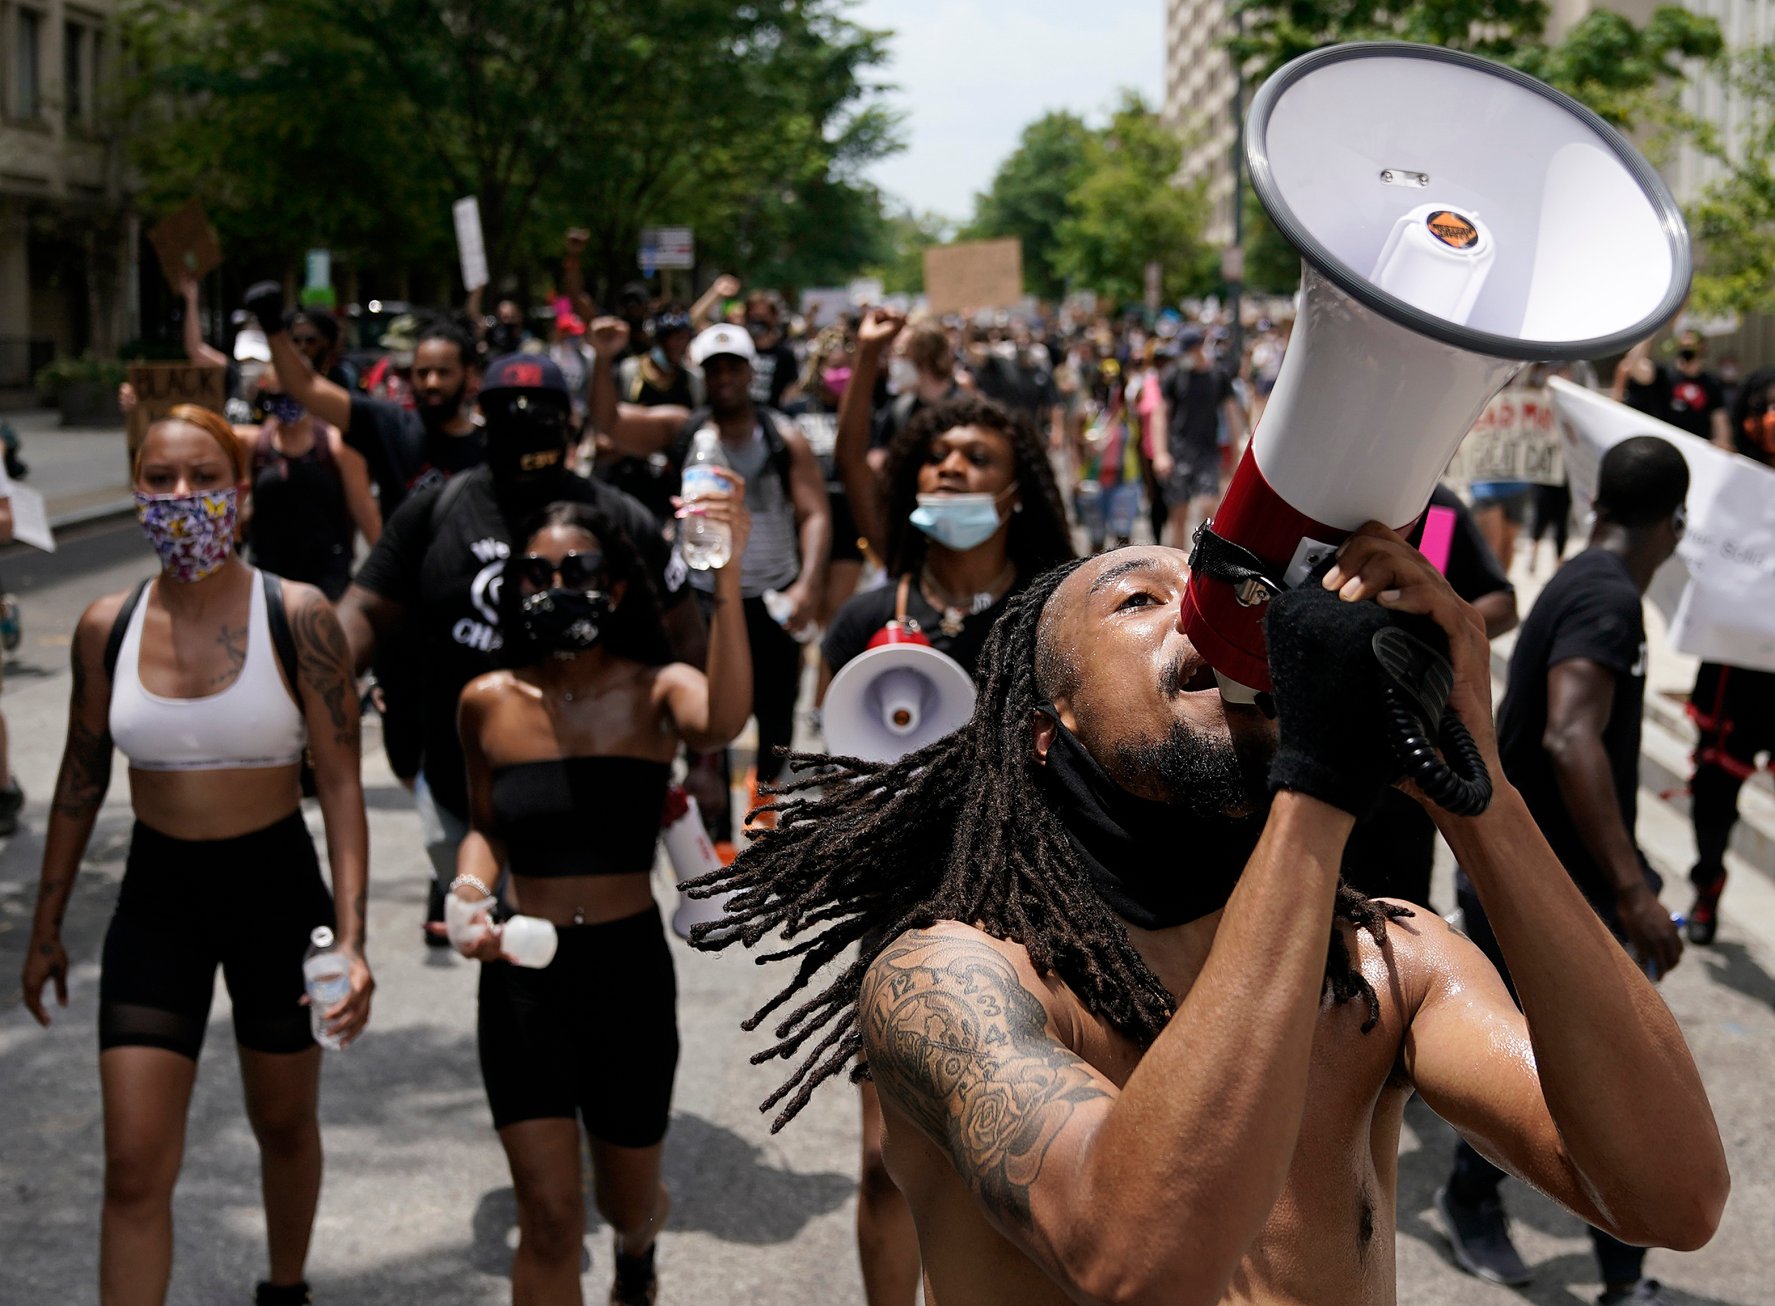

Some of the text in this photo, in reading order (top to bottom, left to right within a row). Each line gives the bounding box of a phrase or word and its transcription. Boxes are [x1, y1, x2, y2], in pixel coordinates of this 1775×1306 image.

[136, 368, 215, 401] BLACK
[888, 973, 915, 1003] 12
[976, 995, 1002, 1018] 3
[983, 1023, 1009, 1048] 4
